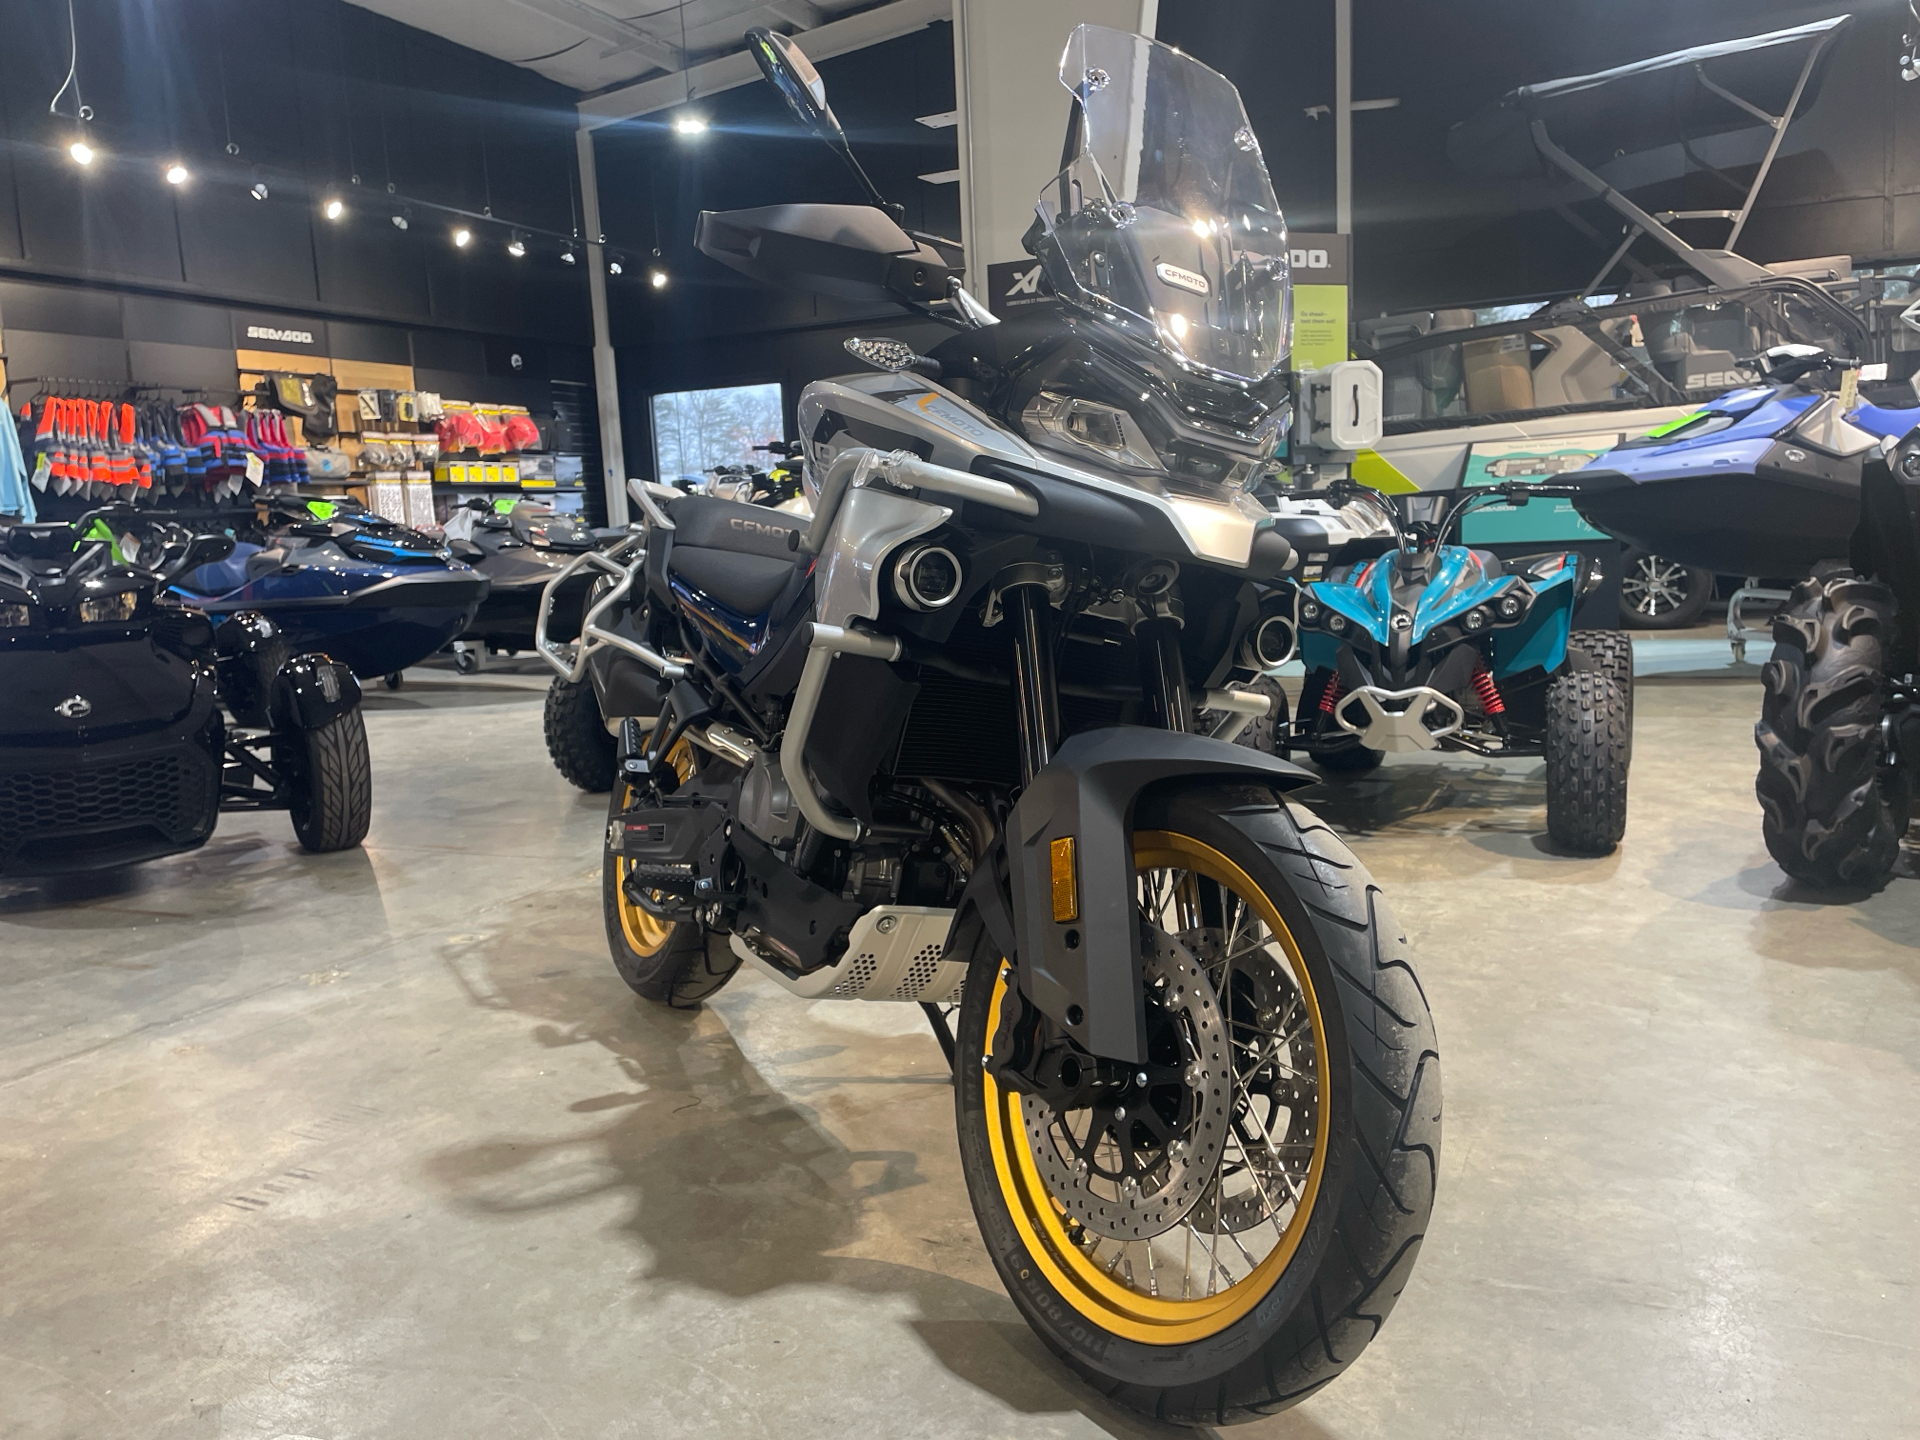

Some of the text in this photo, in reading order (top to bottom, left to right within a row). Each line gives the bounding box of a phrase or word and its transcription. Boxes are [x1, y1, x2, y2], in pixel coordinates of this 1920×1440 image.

[1164, 269, 1206, 288] CFMOTO
[924, 404, 985, 437] CFMOTO
[730, 518, 792, 539] CFMOT
